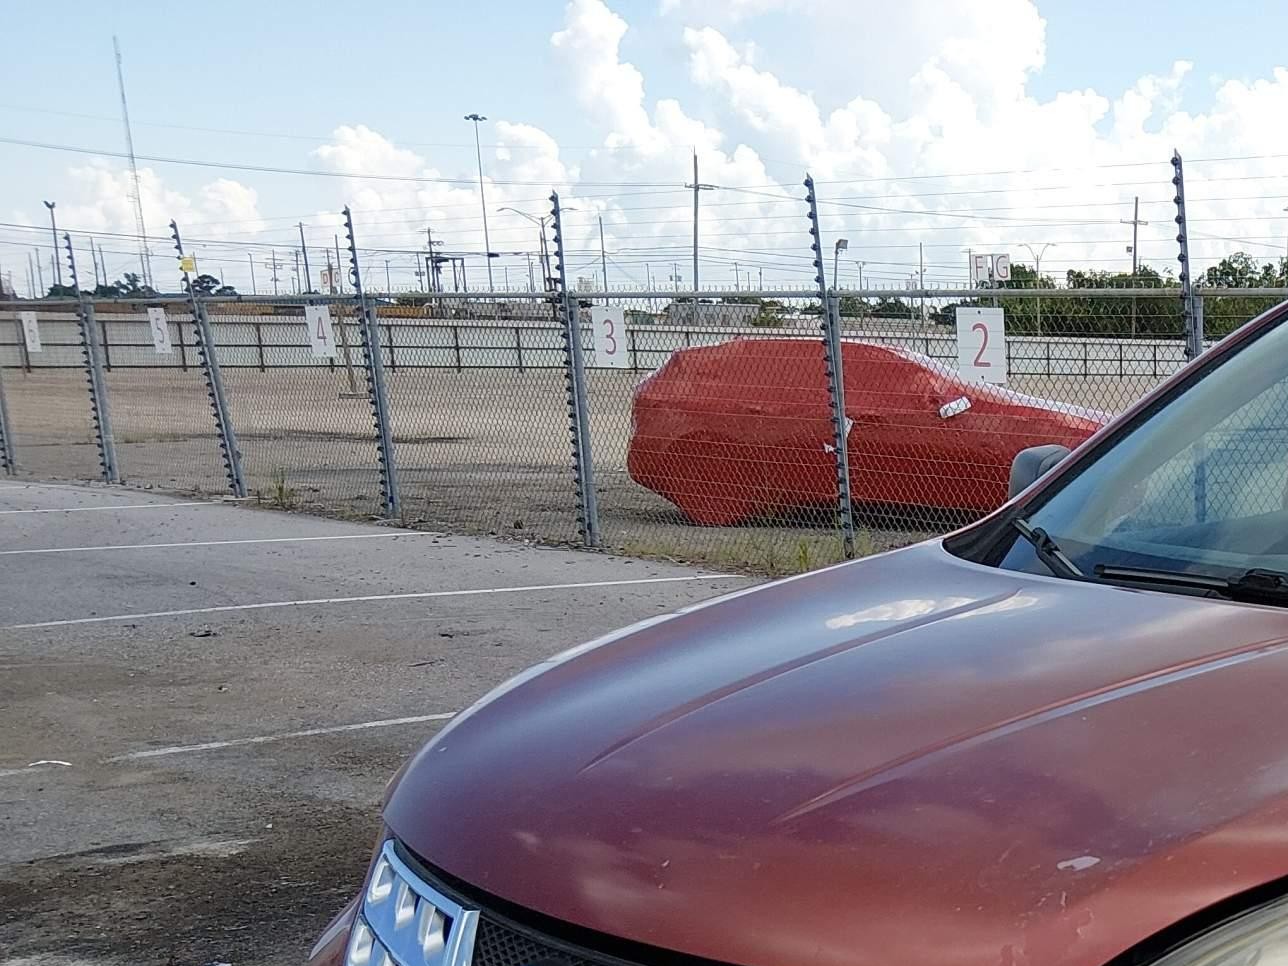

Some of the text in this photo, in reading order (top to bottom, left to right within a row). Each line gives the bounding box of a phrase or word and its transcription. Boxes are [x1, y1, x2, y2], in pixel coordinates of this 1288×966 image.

[975, 256, 983, 280] F
[995, 255, 1009, 279] G
[155, 319, 165, 345] 5
[316, 316, 327, 346] 4
[602, 319, 617, 355] 3
[972, 323, 992, 367] 2
